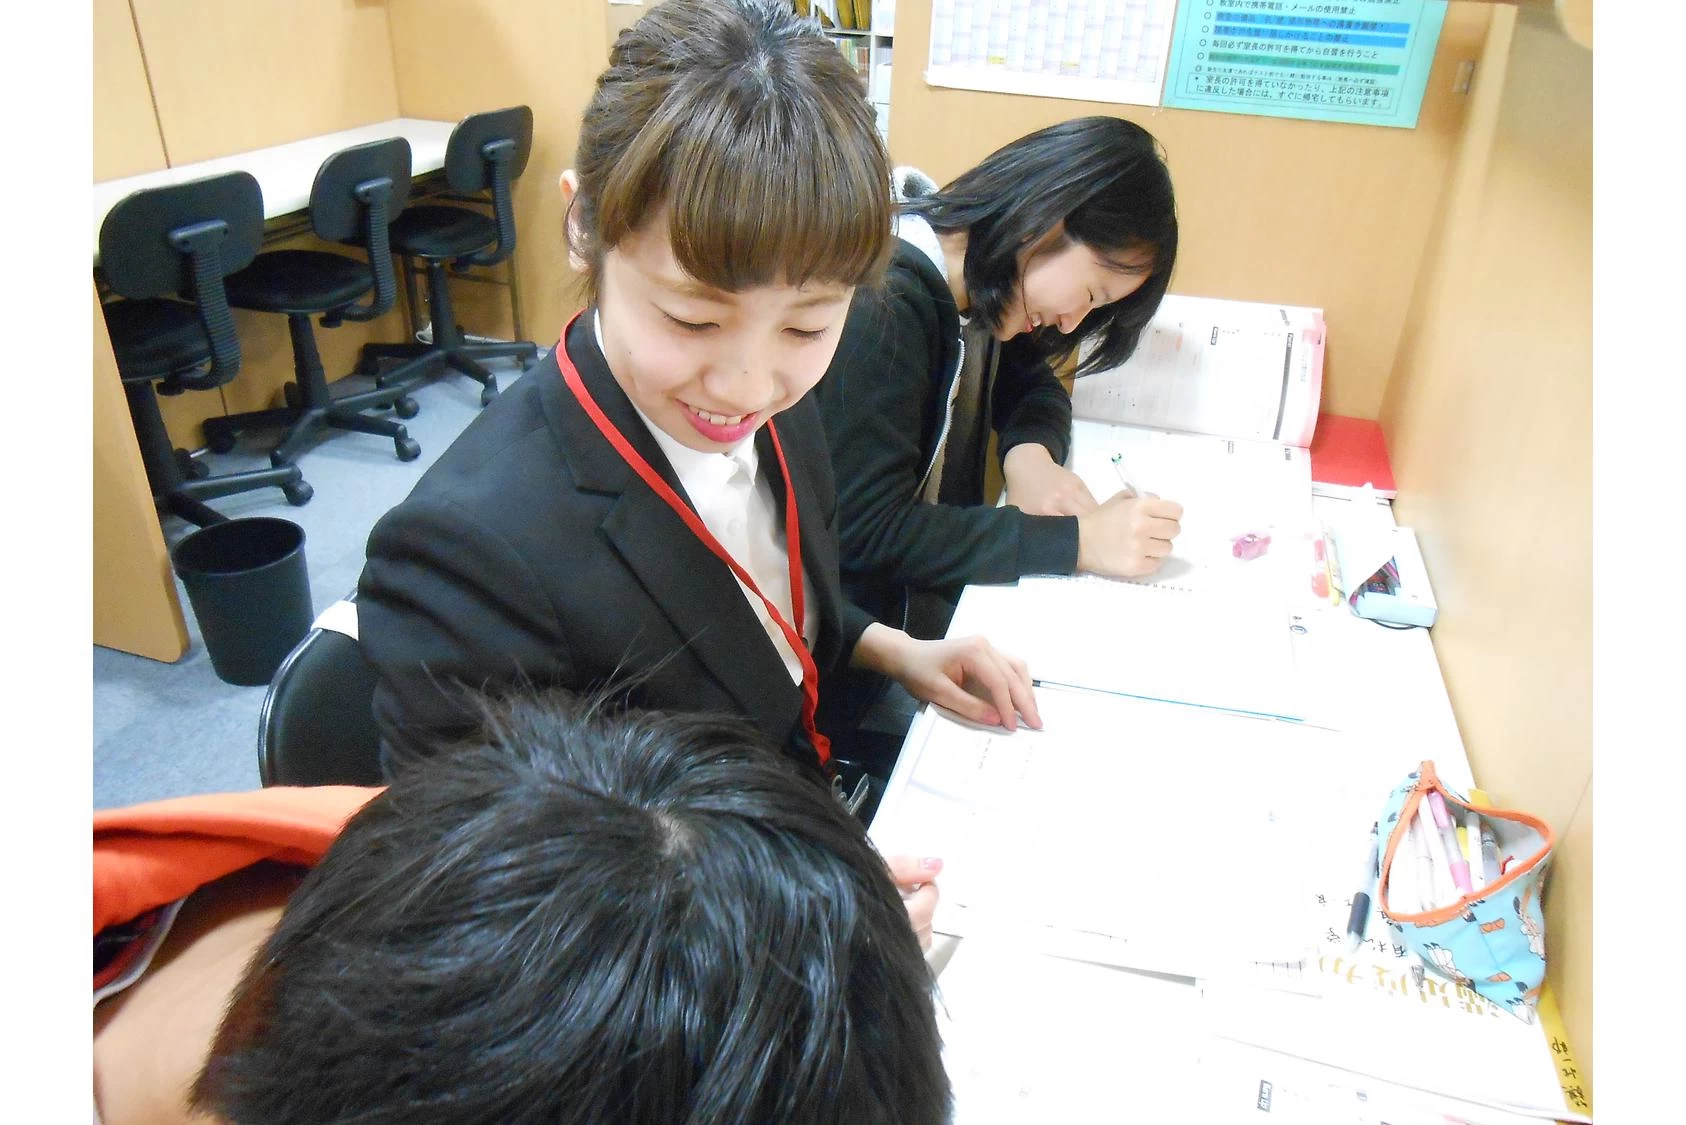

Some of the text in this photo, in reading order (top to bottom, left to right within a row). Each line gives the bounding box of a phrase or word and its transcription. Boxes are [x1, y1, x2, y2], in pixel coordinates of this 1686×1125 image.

[1212, 39, 1379, 60] 毎回必ず室長の許可を得てから自習を行うこと
[1196, 85, 1383, 107] に違反した場合には、すぐに帰宅してもらいます。
[1206, 75, 1389, 98] 室長の許可を得ていなかったり、上記の注意事項
